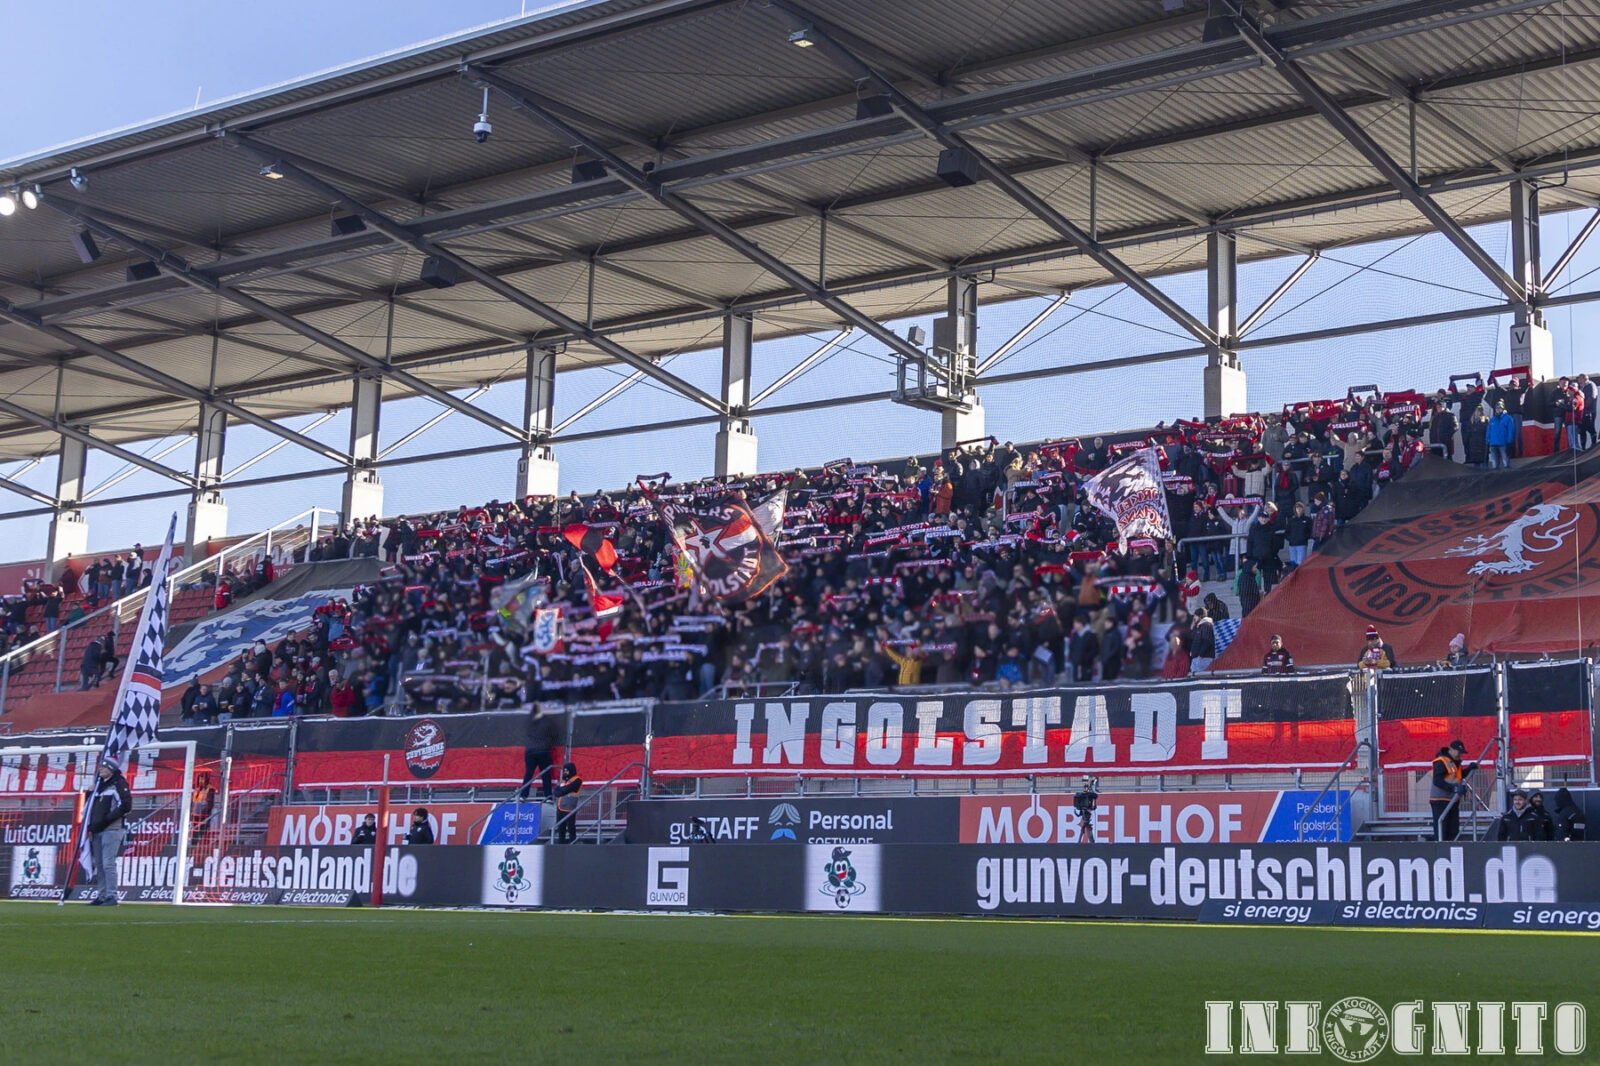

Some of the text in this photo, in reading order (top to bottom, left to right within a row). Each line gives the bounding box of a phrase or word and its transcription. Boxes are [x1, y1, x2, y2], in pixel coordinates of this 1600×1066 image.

[1514, 331, 1526, 345] V
[732, 689, 1242, 765] INGOLSTADT
[809, 809, 893, 830] Personal
[976, 846, 1557, 910] gunvor-deutschland.de
[282, 889, 350, 903] si electronics
[650, 891, 686, 902] GUNVOR
[1223, 901, 1311, 922] si energy
[1342, 901, 1478, 921] si electronics
[1513, 906, 1600, 929] si energ
